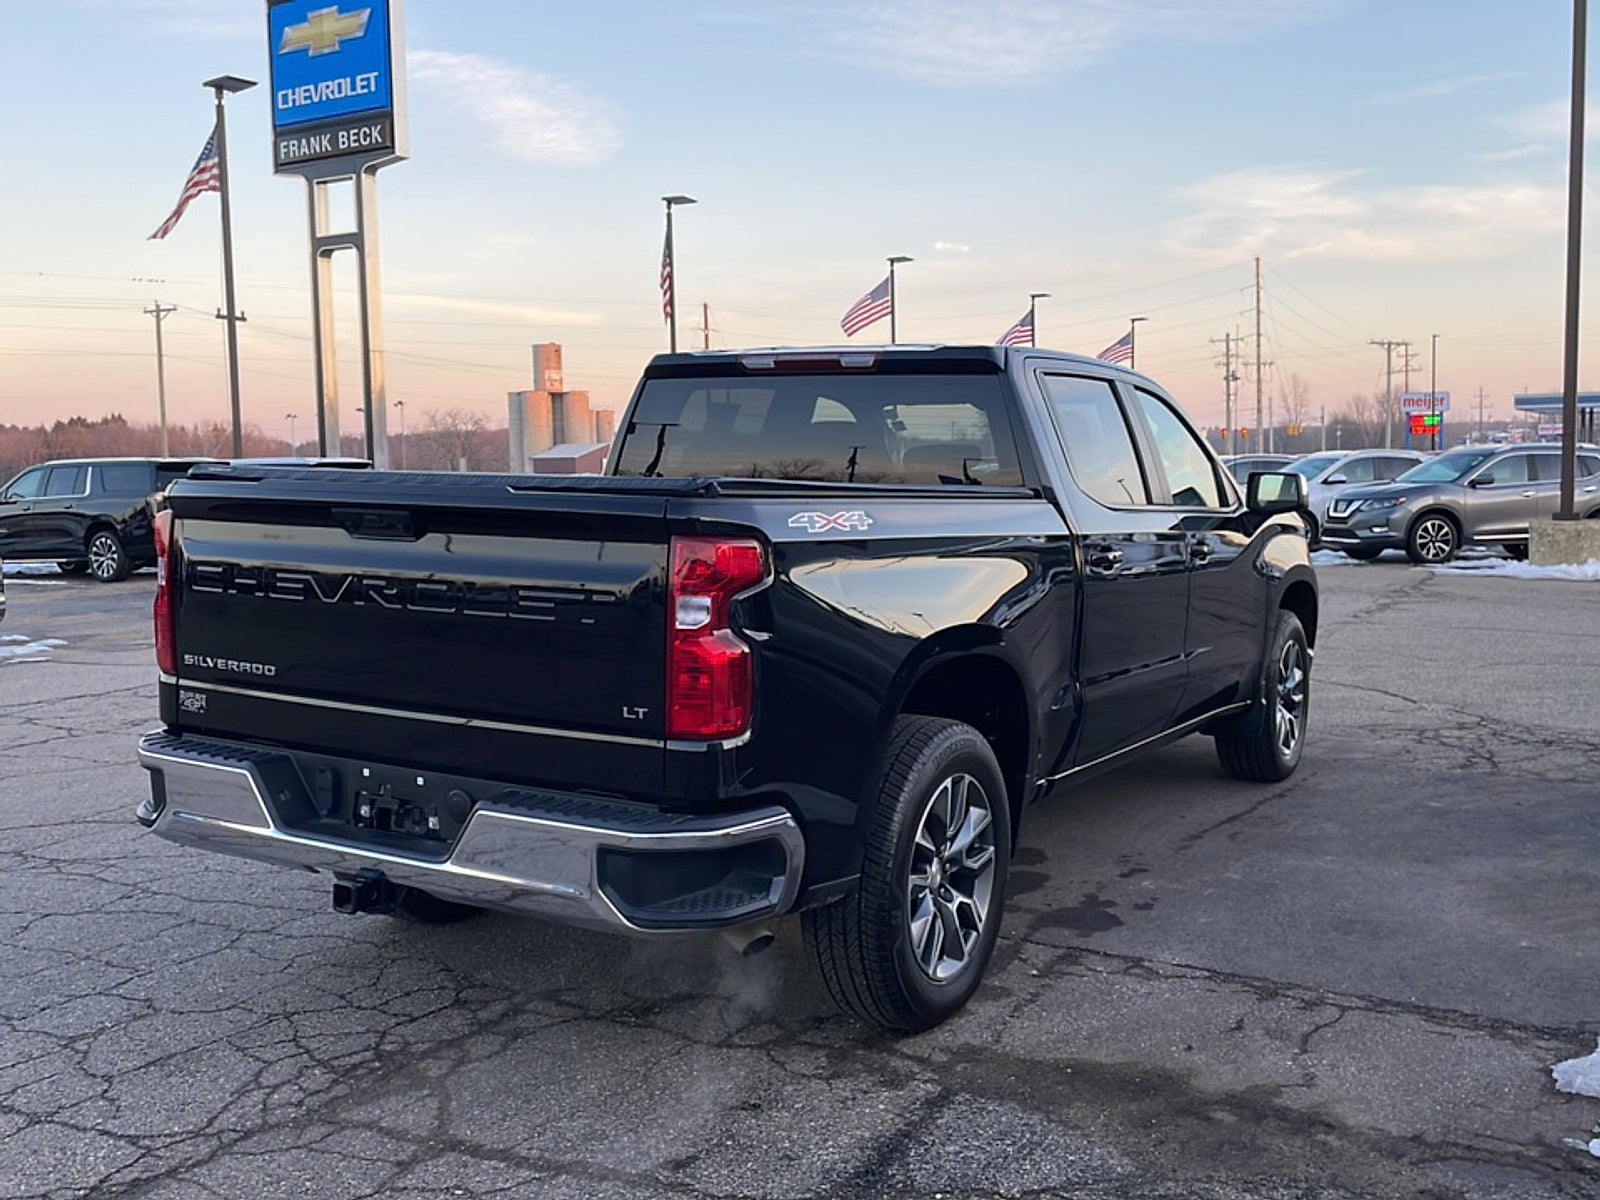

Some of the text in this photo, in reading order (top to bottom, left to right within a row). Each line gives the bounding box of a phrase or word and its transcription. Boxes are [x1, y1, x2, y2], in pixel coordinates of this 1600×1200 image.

[278, 71, 379, 109] CHEVROLET
[280, 125, 383, 159] FRANK BECK
[1403, 393, 1446, 409] meijer
[189, 561, 617, 625] CHEVROLET
[183, 653, 277, 677] SILVERADO
[622, 705, 649, 720] LT
